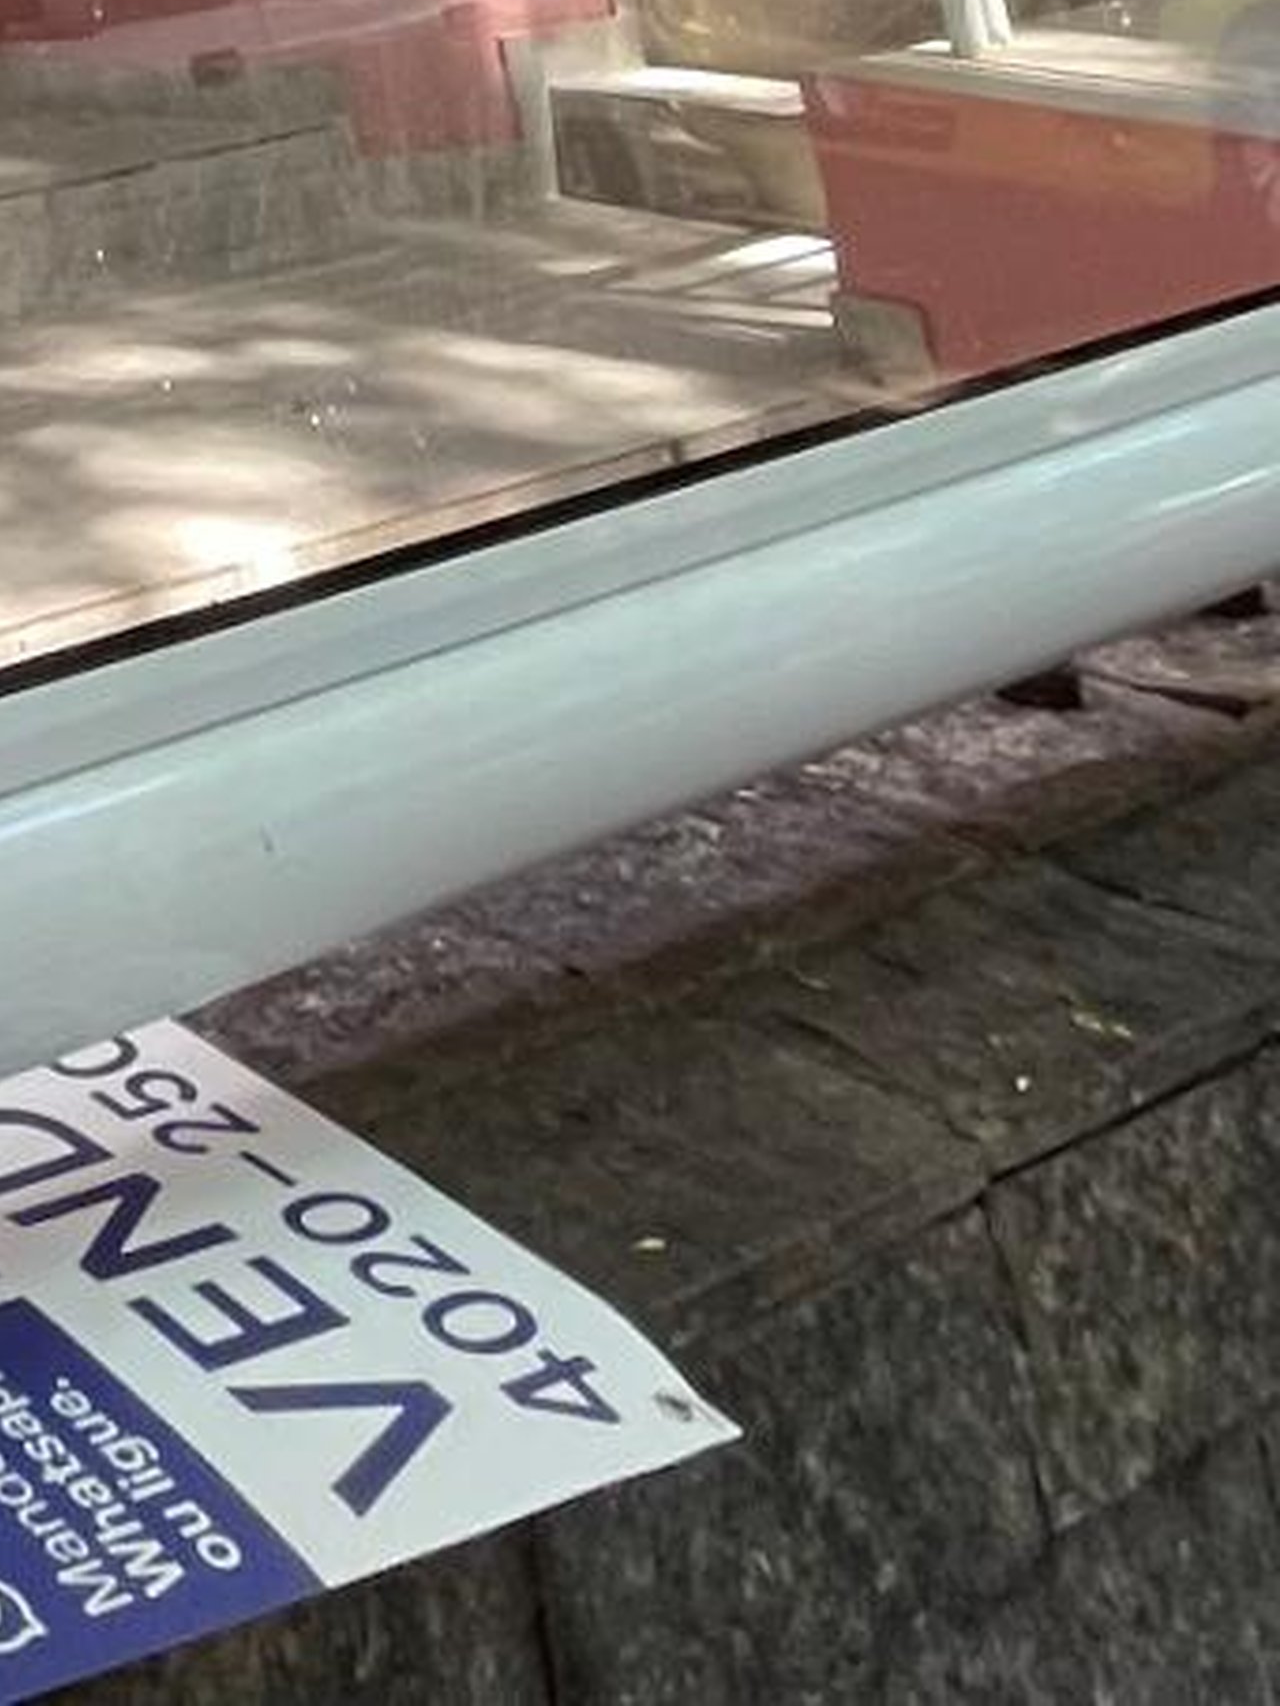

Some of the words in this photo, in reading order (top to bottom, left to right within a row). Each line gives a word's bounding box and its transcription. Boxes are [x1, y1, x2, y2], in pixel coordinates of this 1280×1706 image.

[52, 1034, 622, 1425] 4020-250
[49, 1375, 174, 1502] ligue.
[163, 1499, 242, 1571] ou
